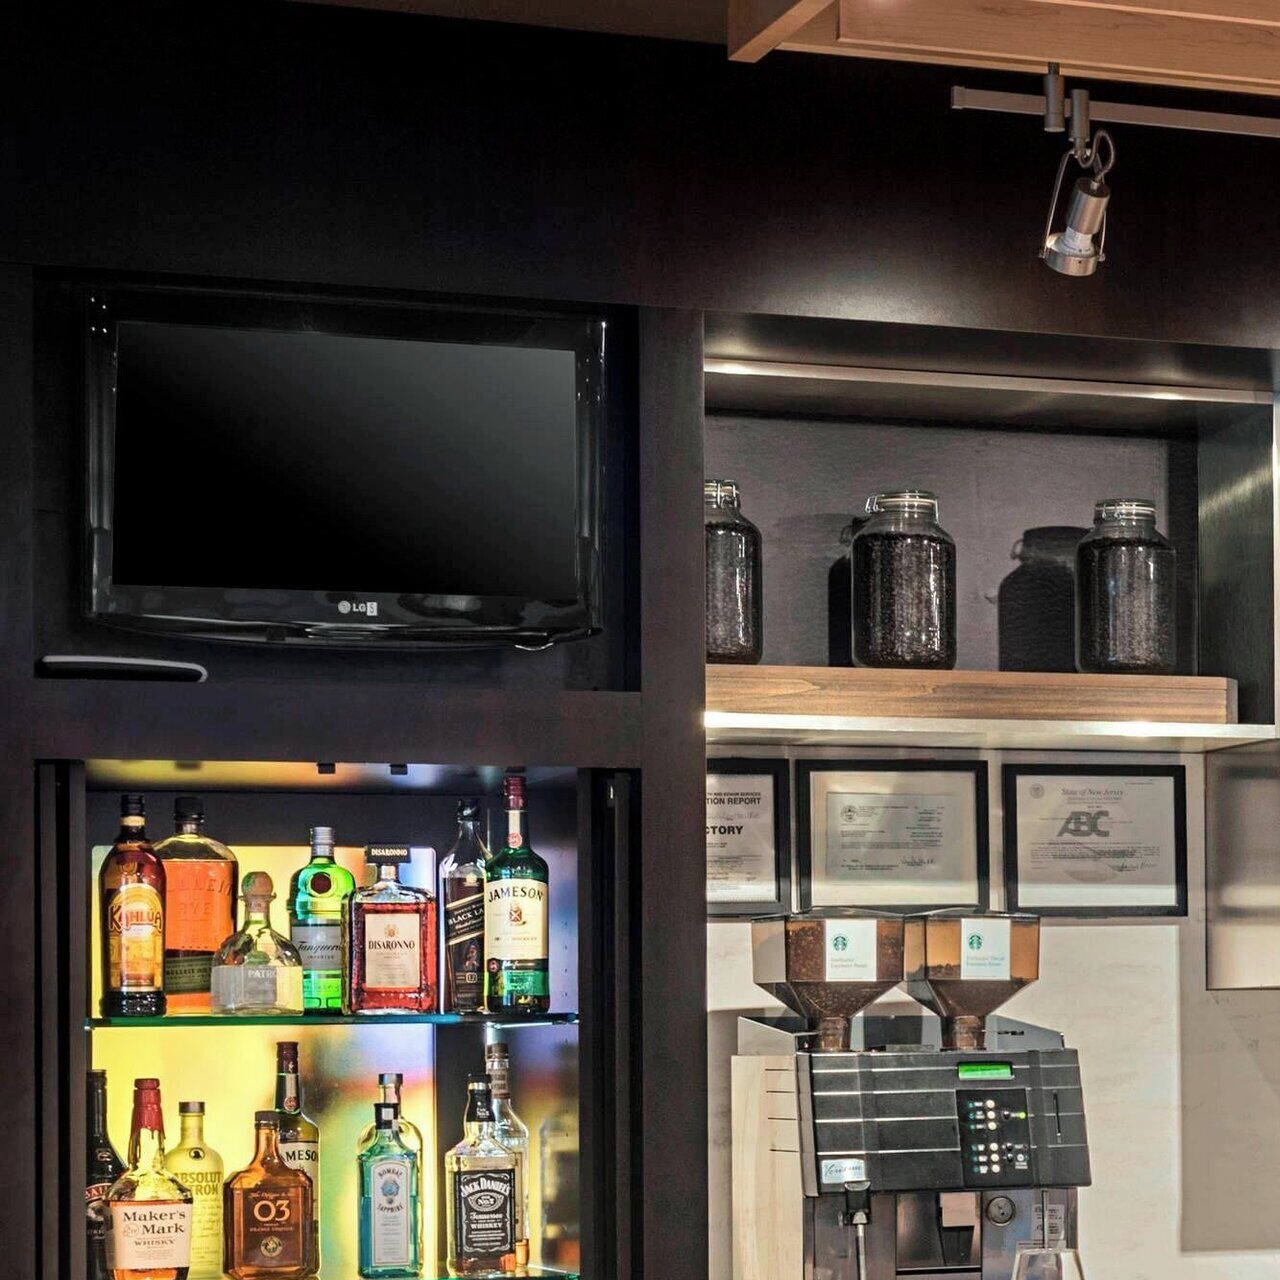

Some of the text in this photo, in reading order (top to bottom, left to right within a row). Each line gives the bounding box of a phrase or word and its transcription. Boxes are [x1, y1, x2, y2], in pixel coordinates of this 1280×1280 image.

[352, 603, 366, 612] LG
[727, 797, 761, 805] REPORT
[1057, 810, 1110, 837] ABC
[371, 848, 408, 856] DISARONNO
[488, 886, 543, 902] JAMESON
[108, 905, 162, 931] KAHLÚA
[448, 911, 473, 925] BLACK
[368, 940, 415, 950] DISARONNO
[248, 970, 276, 978] PATR
[283, 1149, 318, 1162] MESO
[175, 1172, 222, 1183] ABSOLUT
[378, 1167, 403, 1178] BOMBAY
[190, 1185, 219, 1196] TRON
[460, 1180, 480, 1197] JACK
[123, 1210, 187, 1222] Maker's
[253, 1200, 290, 1222] O3
[470, 1212, 502, 1220] Tennessee
[141, 1223, 185, 1235] Mark
